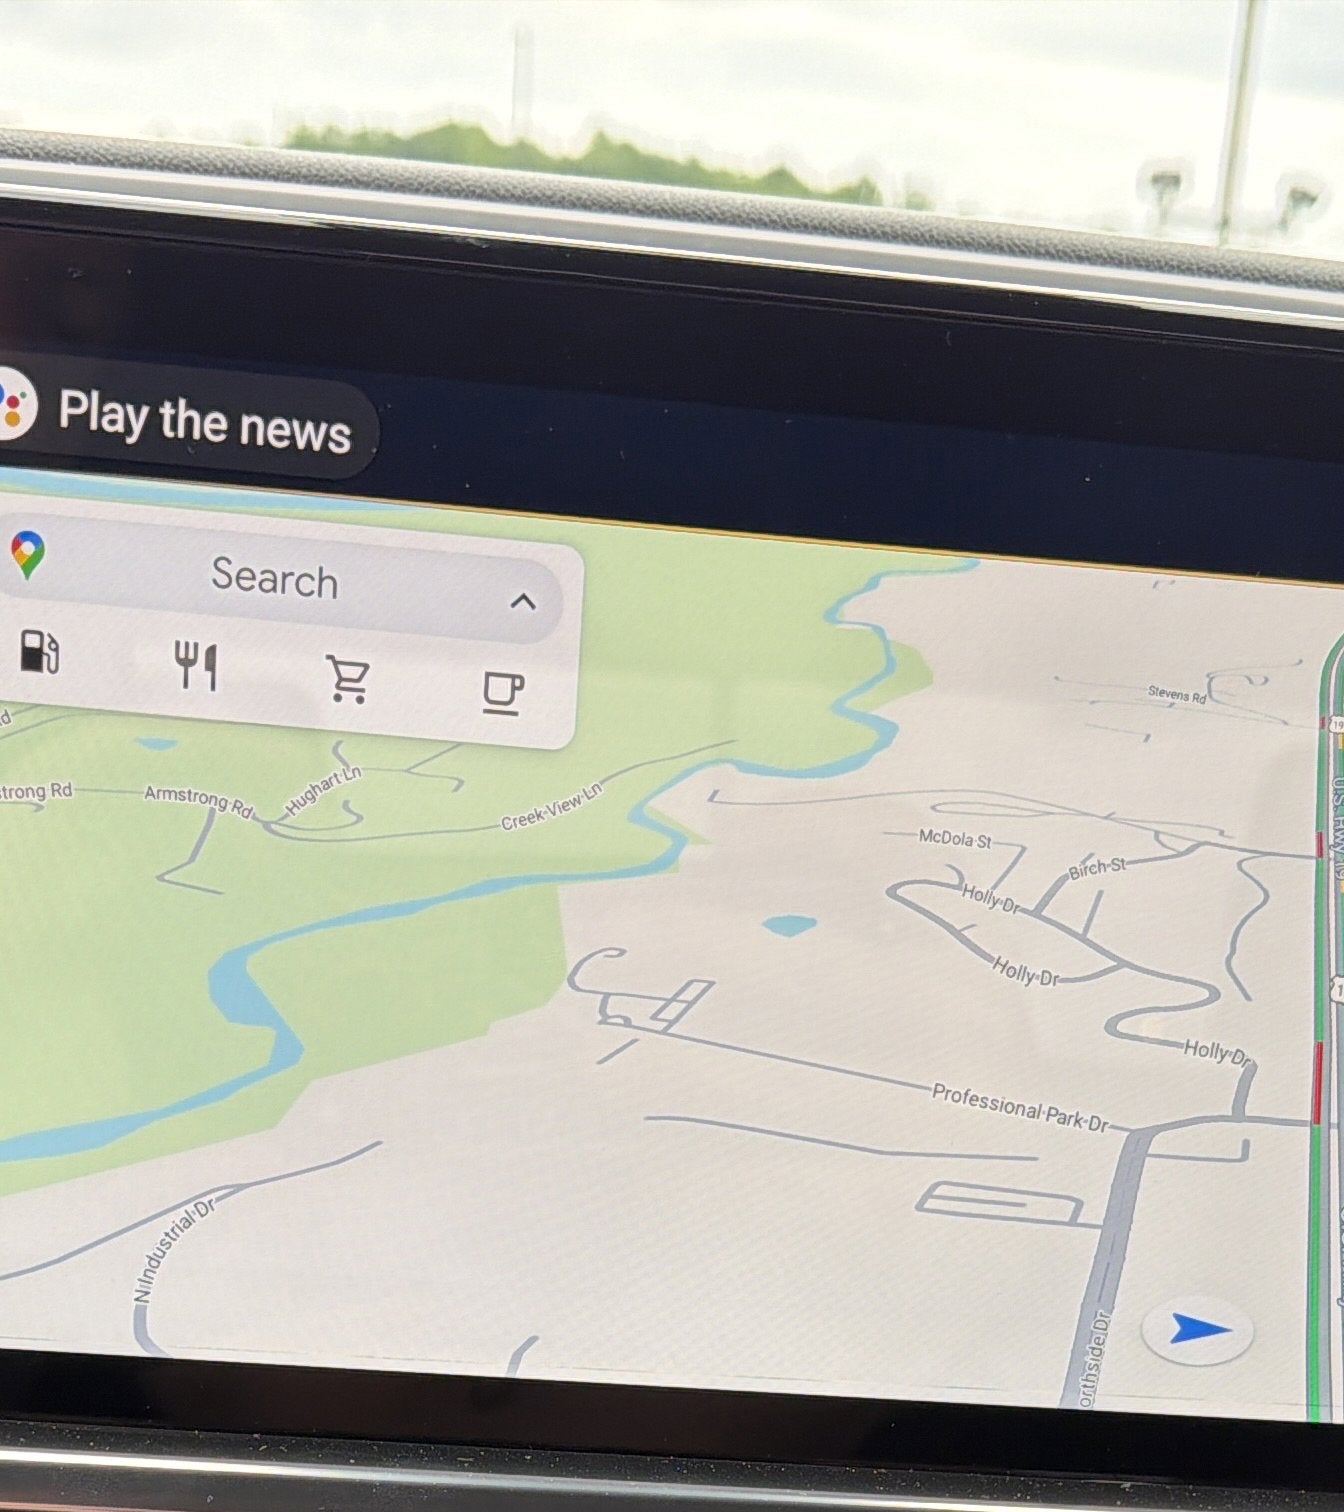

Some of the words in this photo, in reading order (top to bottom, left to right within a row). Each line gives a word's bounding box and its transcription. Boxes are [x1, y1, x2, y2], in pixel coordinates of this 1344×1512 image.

[60, 391, 148, 444] Play
[160, 400, 228, 442] the
[239, 412, 353, 455] news
[211, 555, 339, 602] Search
[1147, 684, 1191, 702] Stevens
[1191, 689, 1208, 705] Rd
[1334, 720, 1344, 730] 19
[50, 781, 73, 799] Rd
[144, 786, 229, 813] Armstrong
[230, 800, 253, 820] Rd
[284, 771, 343, 817] Hughart
[341, 764, 362, 783] Ln
[500, 807, 544, 832] Creek
[544, 794, 582, 818] View
[580, 781, 604, 802] Ln
[919, 828, 975, 848] McDola
[976, 833, 992, 849] St
[1068, 859, 1107, 882] Birch
[1108, 857, 1127, 873] St
[961, 883, 999, 910] Holly
[1000, 897, 1020, 916] Dr
[992, 955, 1036, 986] Holly
[1039, 970, 1061, 988] Dr
[1183, 1039, 1230, 1064] Holly
[1231, 1048, 1251, 1068] Dr
[932, 1082, 1042, 1120] Professional
[1045, 1106, 1085, 1129] Park
[1088, 1115, 1109, 1134] Dr
[193, 1198, 216, 1218] Dr
[137, 1209, 197, 1285] Industrial
[133, 1288, 152, 1304] N
[1092, 1311, 1112, 1332] Dr
[1079, 1336, 1106, 1408] orthside
